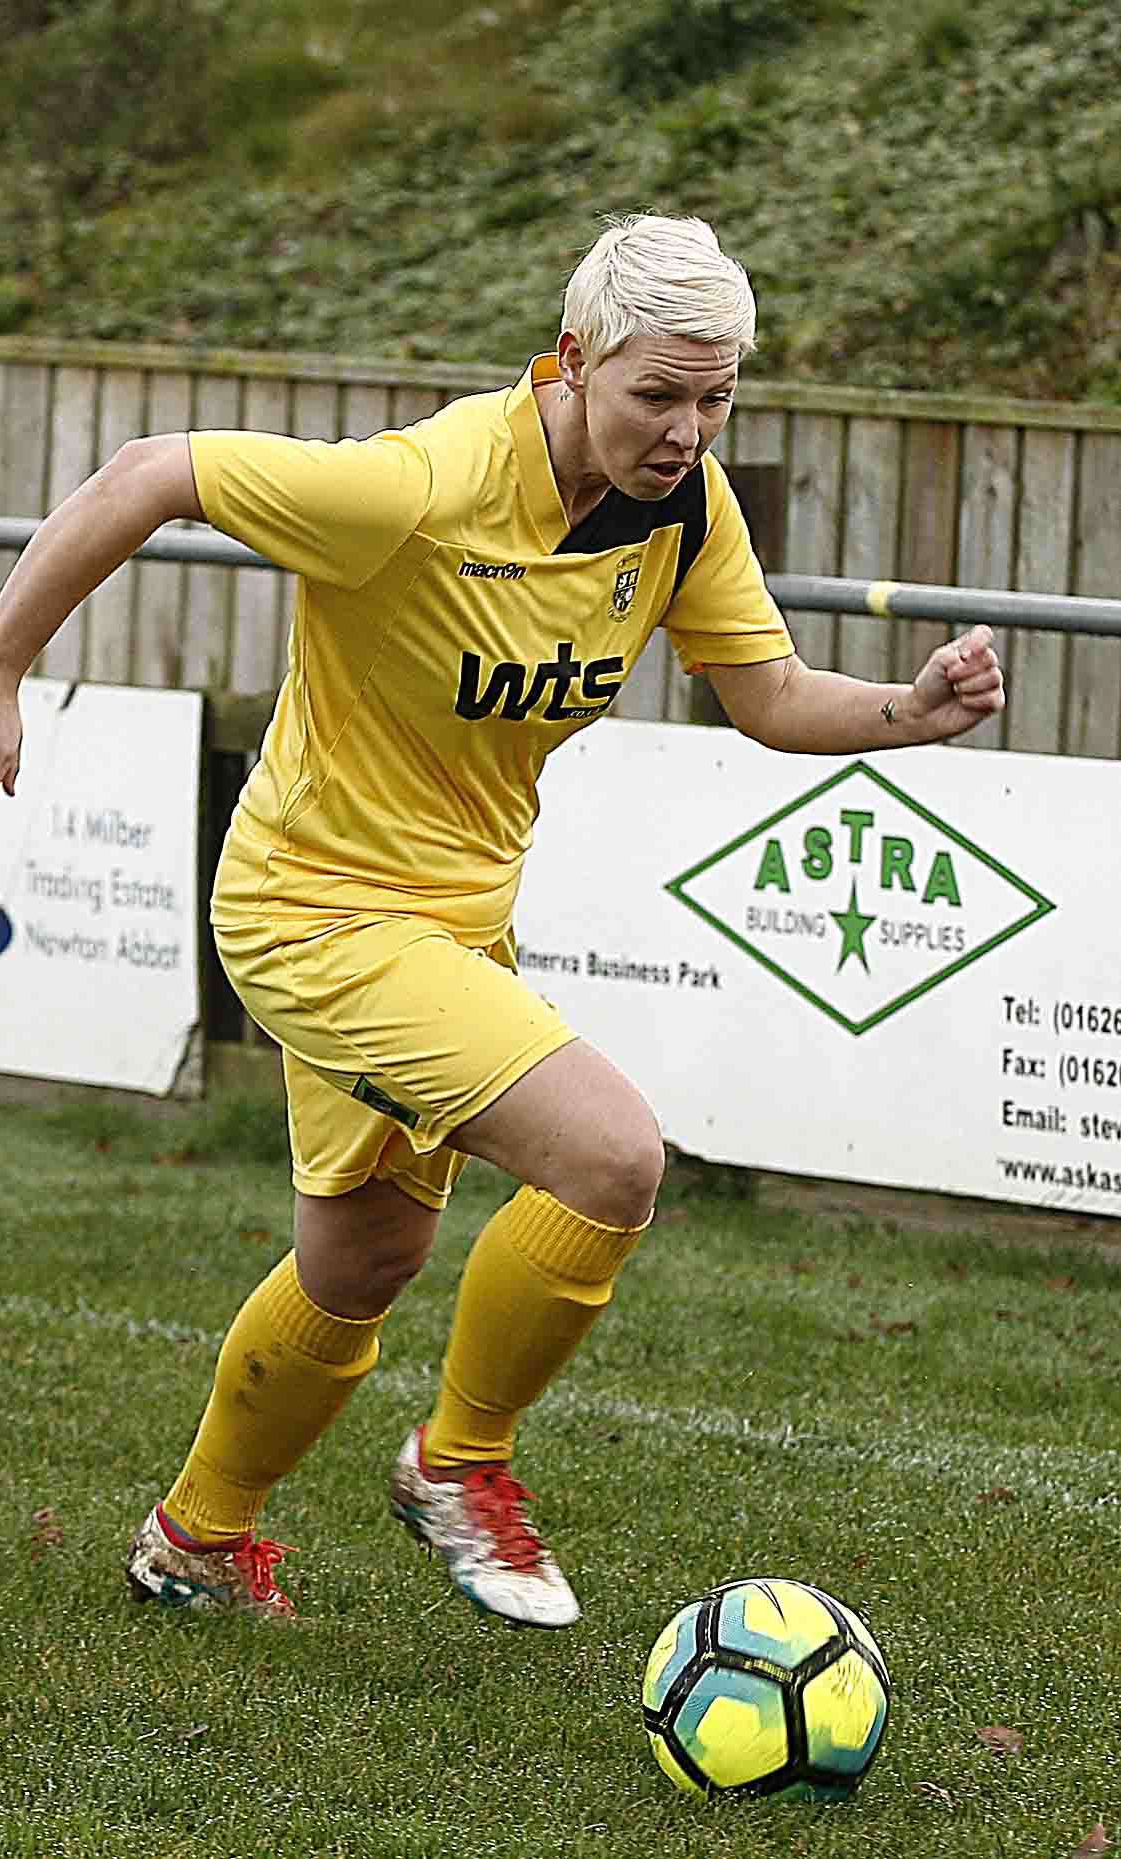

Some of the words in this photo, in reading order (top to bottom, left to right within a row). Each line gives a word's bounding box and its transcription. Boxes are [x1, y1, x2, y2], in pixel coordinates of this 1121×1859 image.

[753, 808, 963, 908] ASTRA
[25, 920, 107, 961] Newton
[116, 925, 181, 973] Abbot
[746, 905, 826, 938] BUILDING
[880, 918, 966, 952] SUPPLIES
[587, 951, 671, 985] Business
[679, 961, 722, 990] Park
[1003, 996, 1040, 1026] Tel:
[1003, 1048, 1045, 1080] Fax:
[1059, 1054, 1121, 1090] (0162
[1003, 1100, 1067, 1134] Email:
